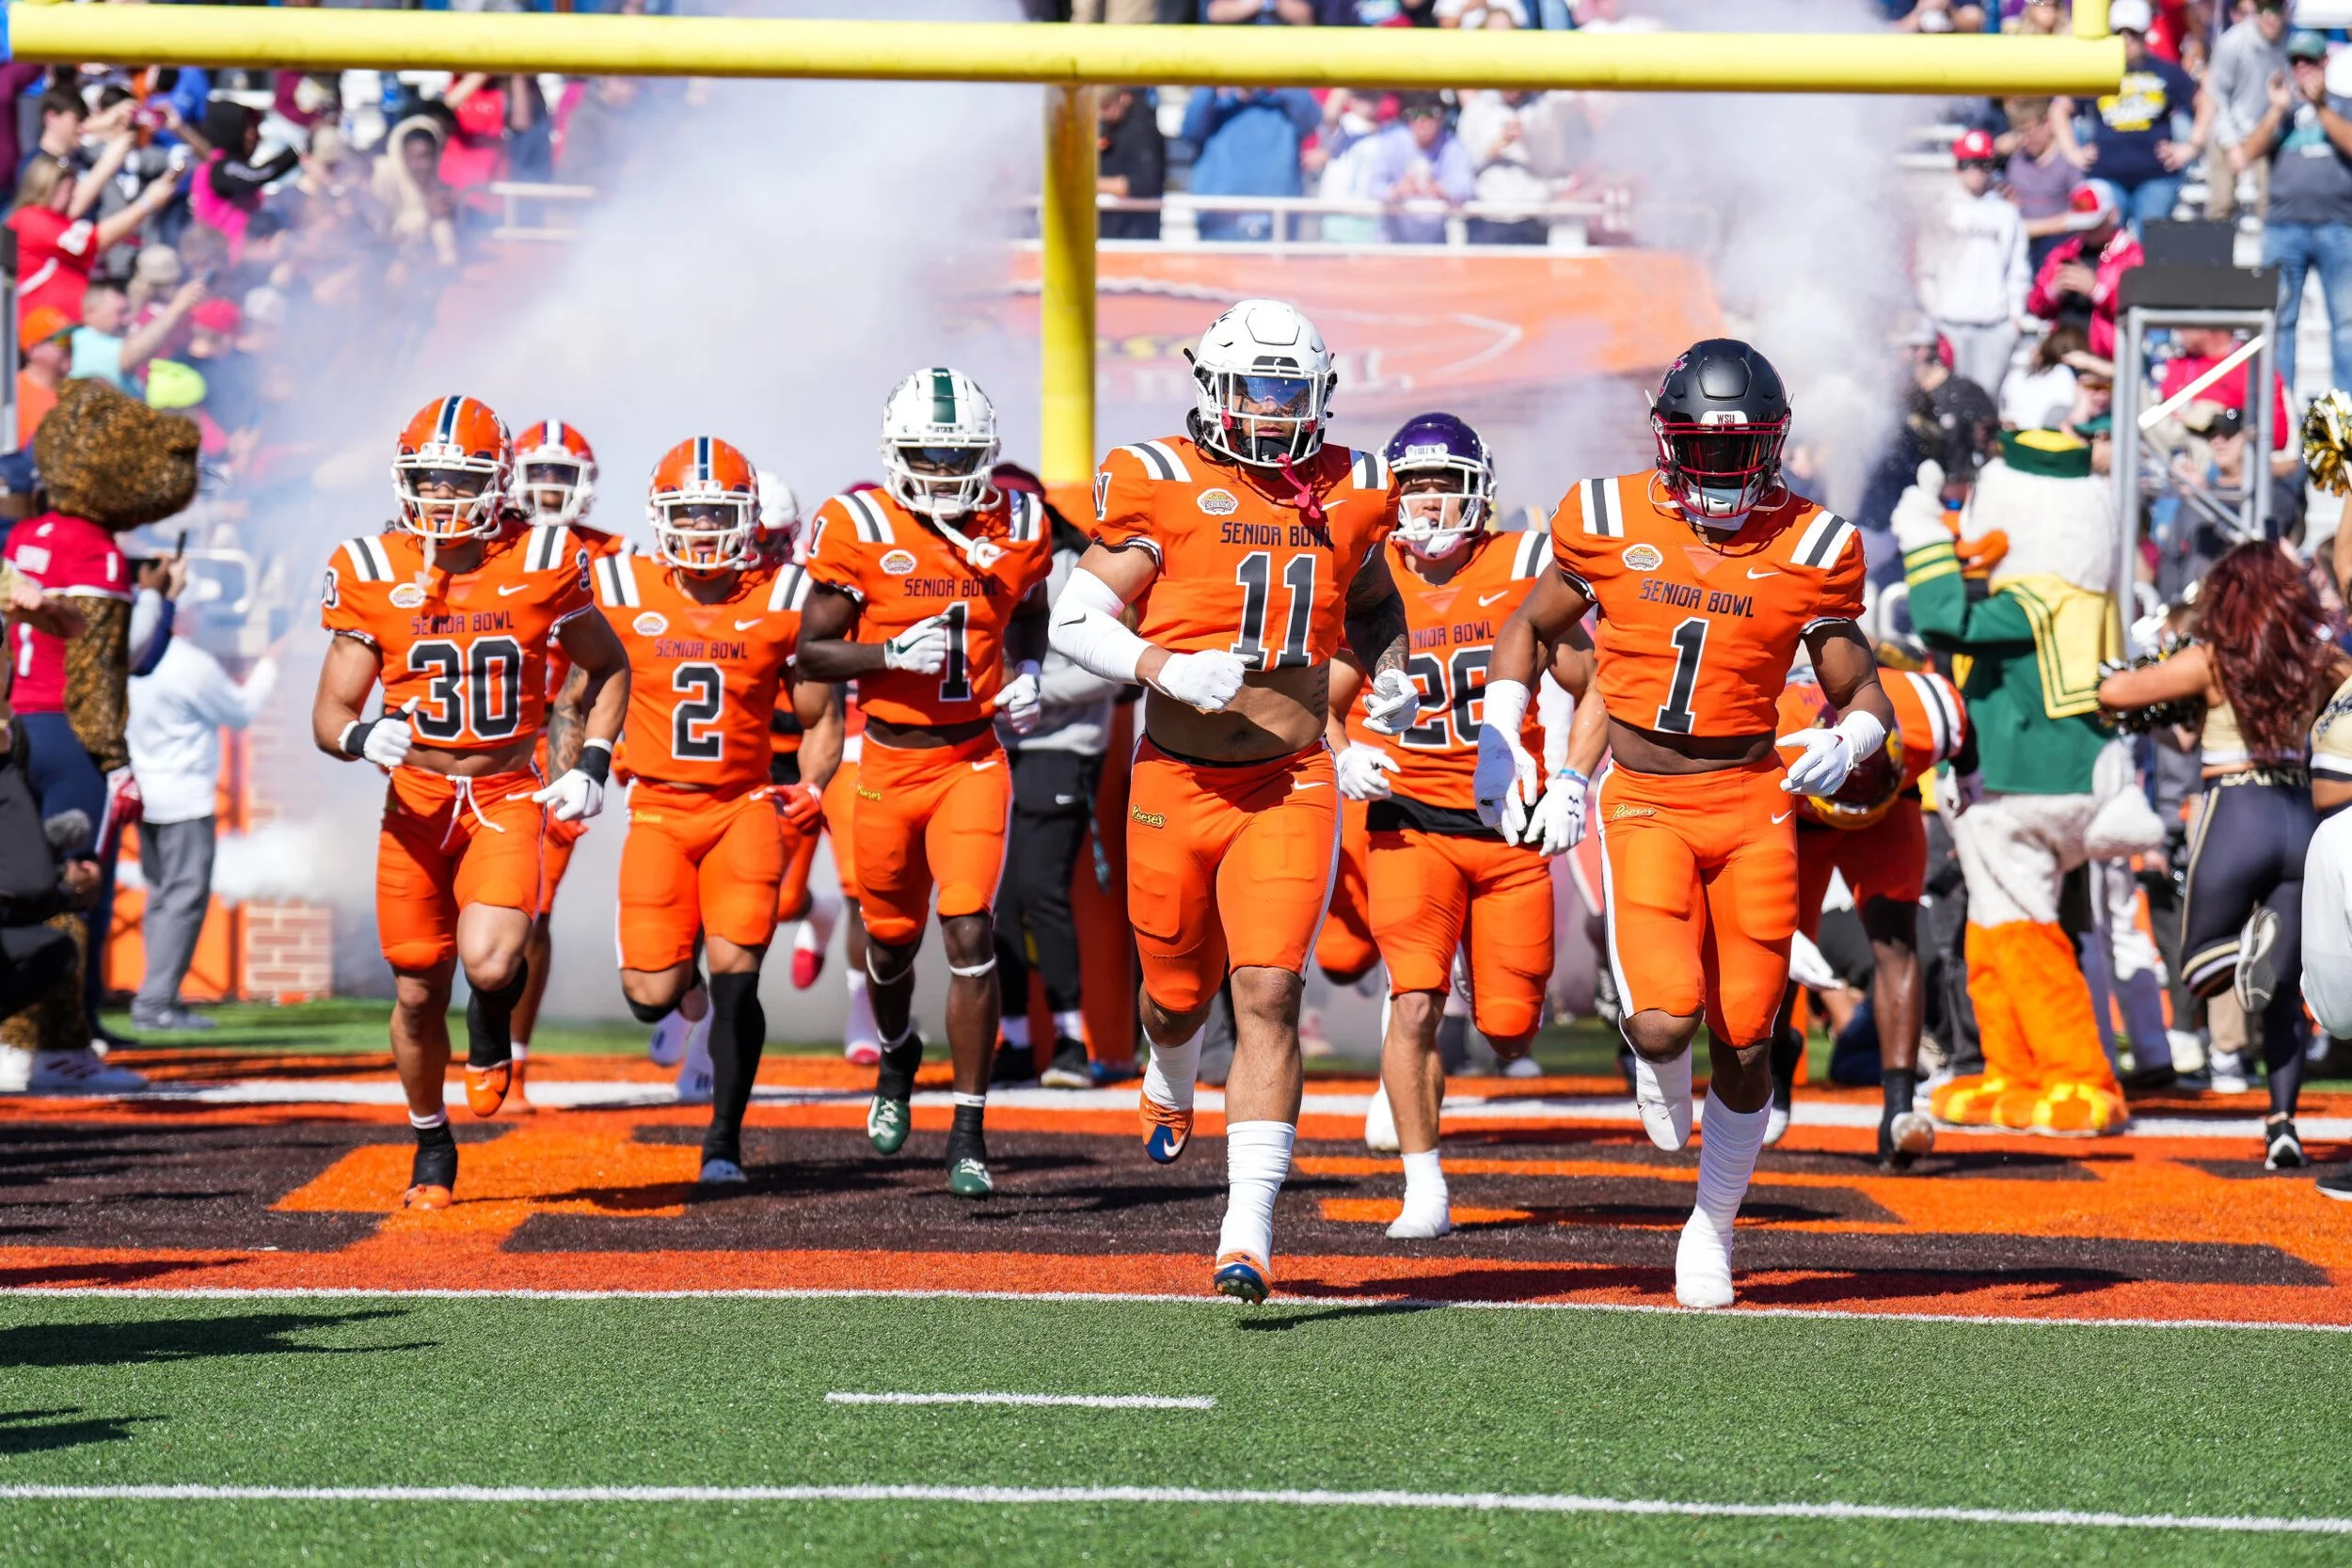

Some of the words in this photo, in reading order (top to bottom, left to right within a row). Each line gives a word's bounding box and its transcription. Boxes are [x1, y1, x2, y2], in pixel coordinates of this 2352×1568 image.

[1716, 414, 1736, 423] WSU
[1220, 522, 1281, 546] SENIOR
[1289, 526, 1335, 548] BOWL
[904, 578, 955, 597] SENIOR
[961, 578, 999, 597] BOWL
[1639, 578, 1703, 610] SENIOR
[1707, 591, 1755, 617] BOWL
[410, 615, 465, 636] SENIOR
[473, 610, 515, 632] BOWL
[1231, 550, 1316, 673] 11
[655, 639, 704, 658] SENIOR
[710, 641, 748, 659] BOWL
[939, 601, 971, 702] 1
[1409, 626, 1447, 650] NIOR
[1453, 620, 1495, 643] BOWL
[406, 635, 523, 742] 30
[1654, 617, 1710, 735] 1
[672, 661, 725, 762] 2
